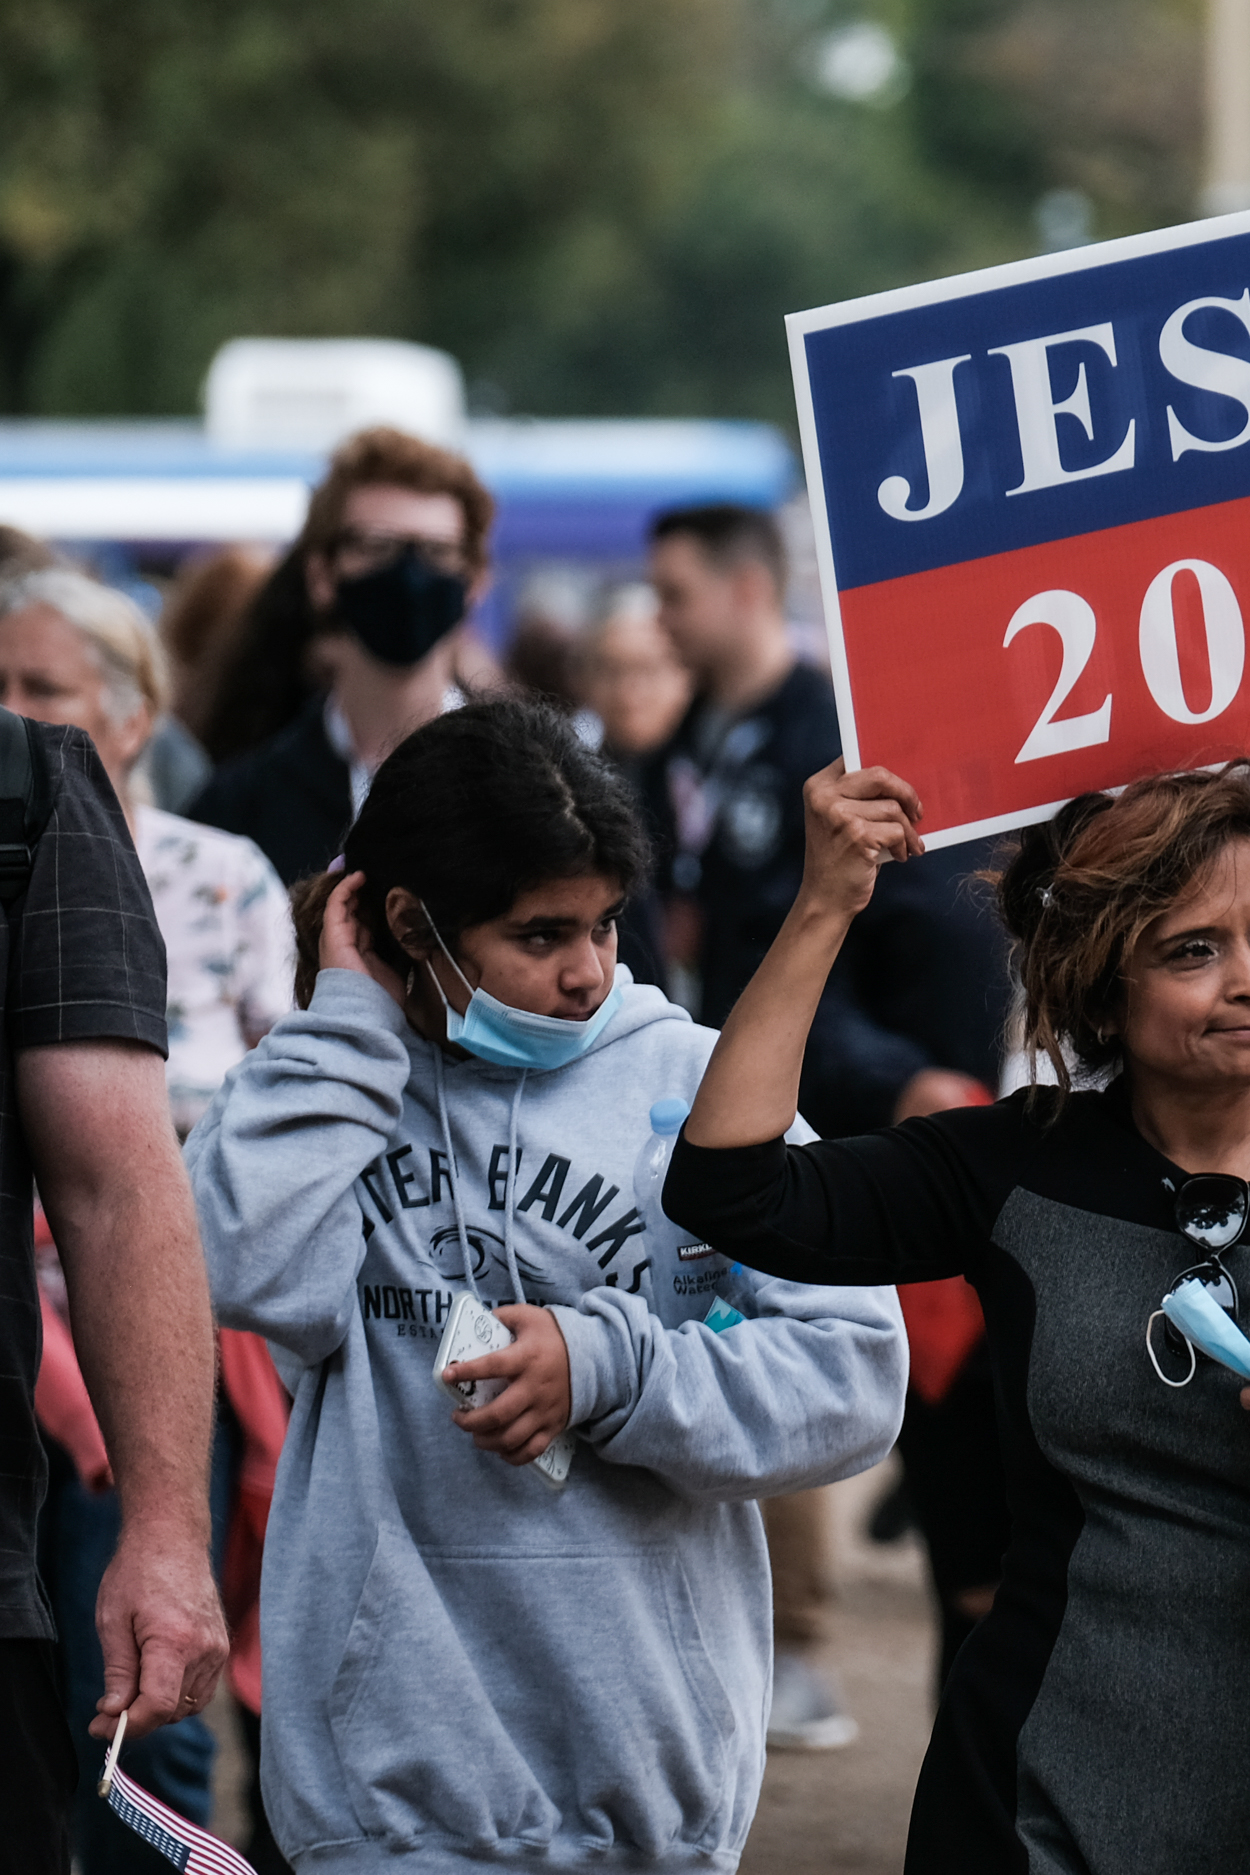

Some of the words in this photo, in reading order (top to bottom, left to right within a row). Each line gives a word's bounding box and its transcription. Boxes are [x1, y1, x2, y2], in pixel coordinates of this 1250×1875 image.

[488, 1144, 652, 1294] BANKS
[673, 1267, 728, 1285] Alkaline
[364, 1284, 453, 1323] NORTH
